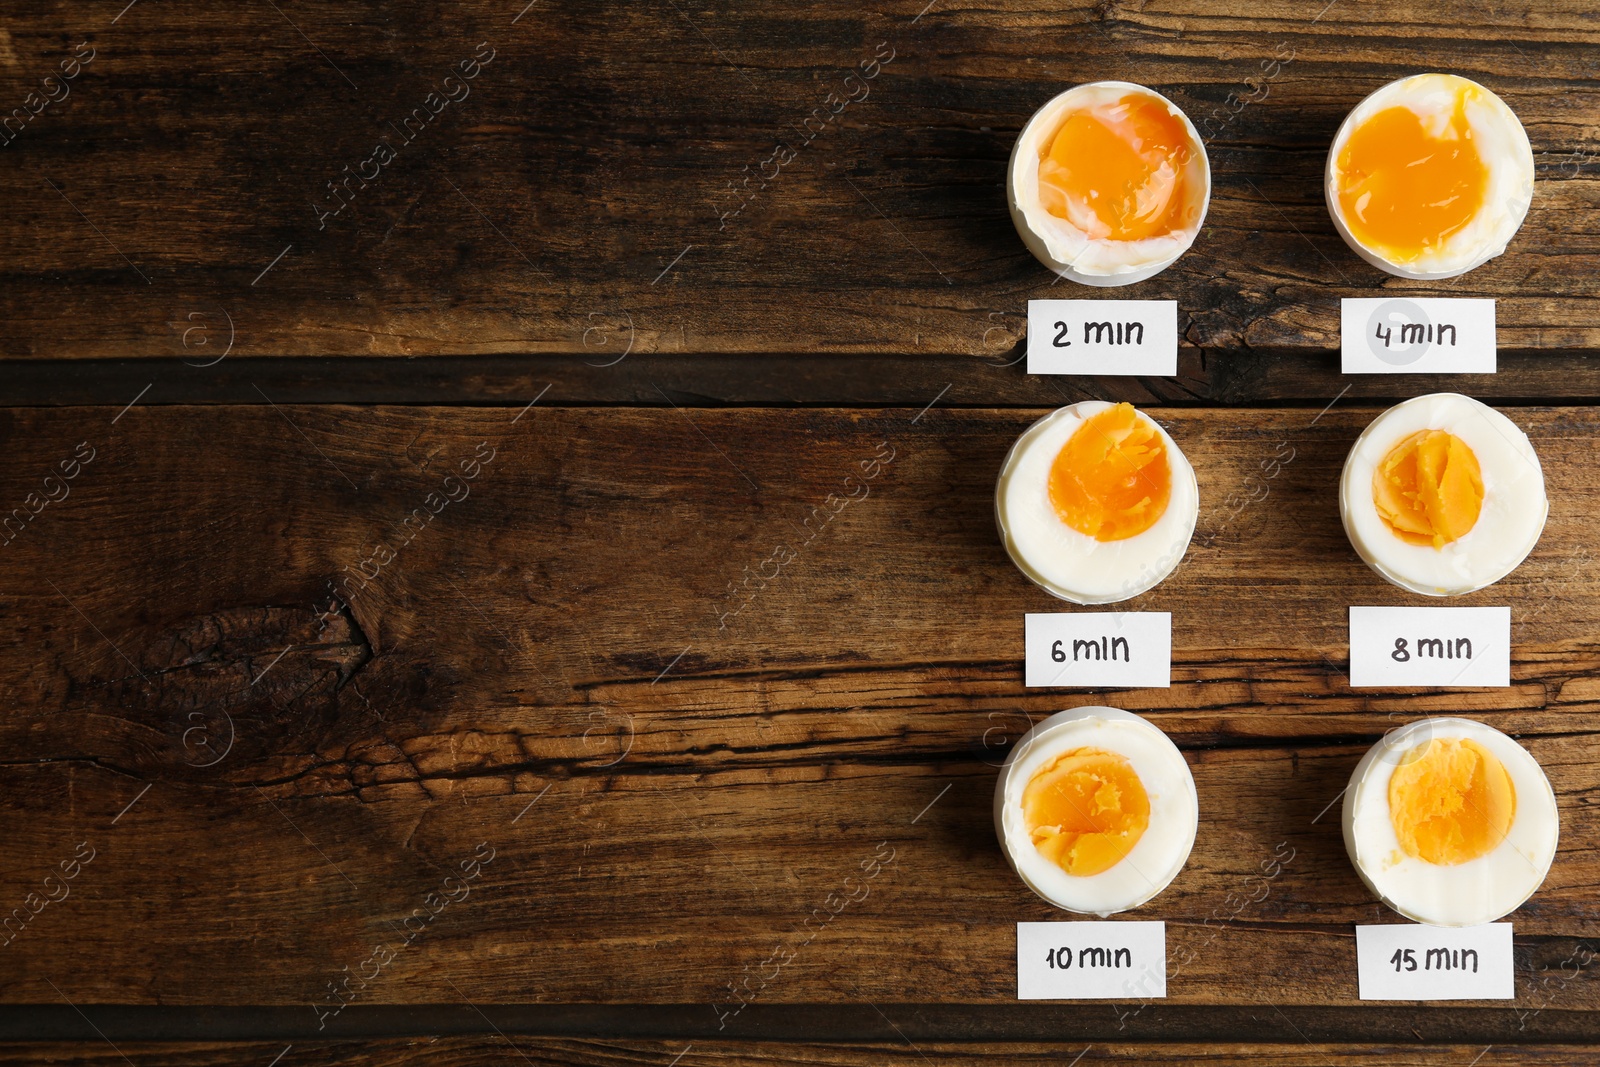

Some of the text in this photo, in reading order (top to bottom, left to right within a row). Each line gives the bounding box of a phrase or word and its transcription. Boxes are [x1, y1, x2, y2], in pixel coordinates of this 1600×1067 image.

[1053, 321, 1144, 348] 2 min
[1375, 322, 1457, 347] 4 min
[1051, 636, 1130, 662] 6 min
[1391, 637, 1472, 662] 8 min
[1046, 946, 1131, 970] 10 min
[1390, 947, 1478, 973] 15 min
